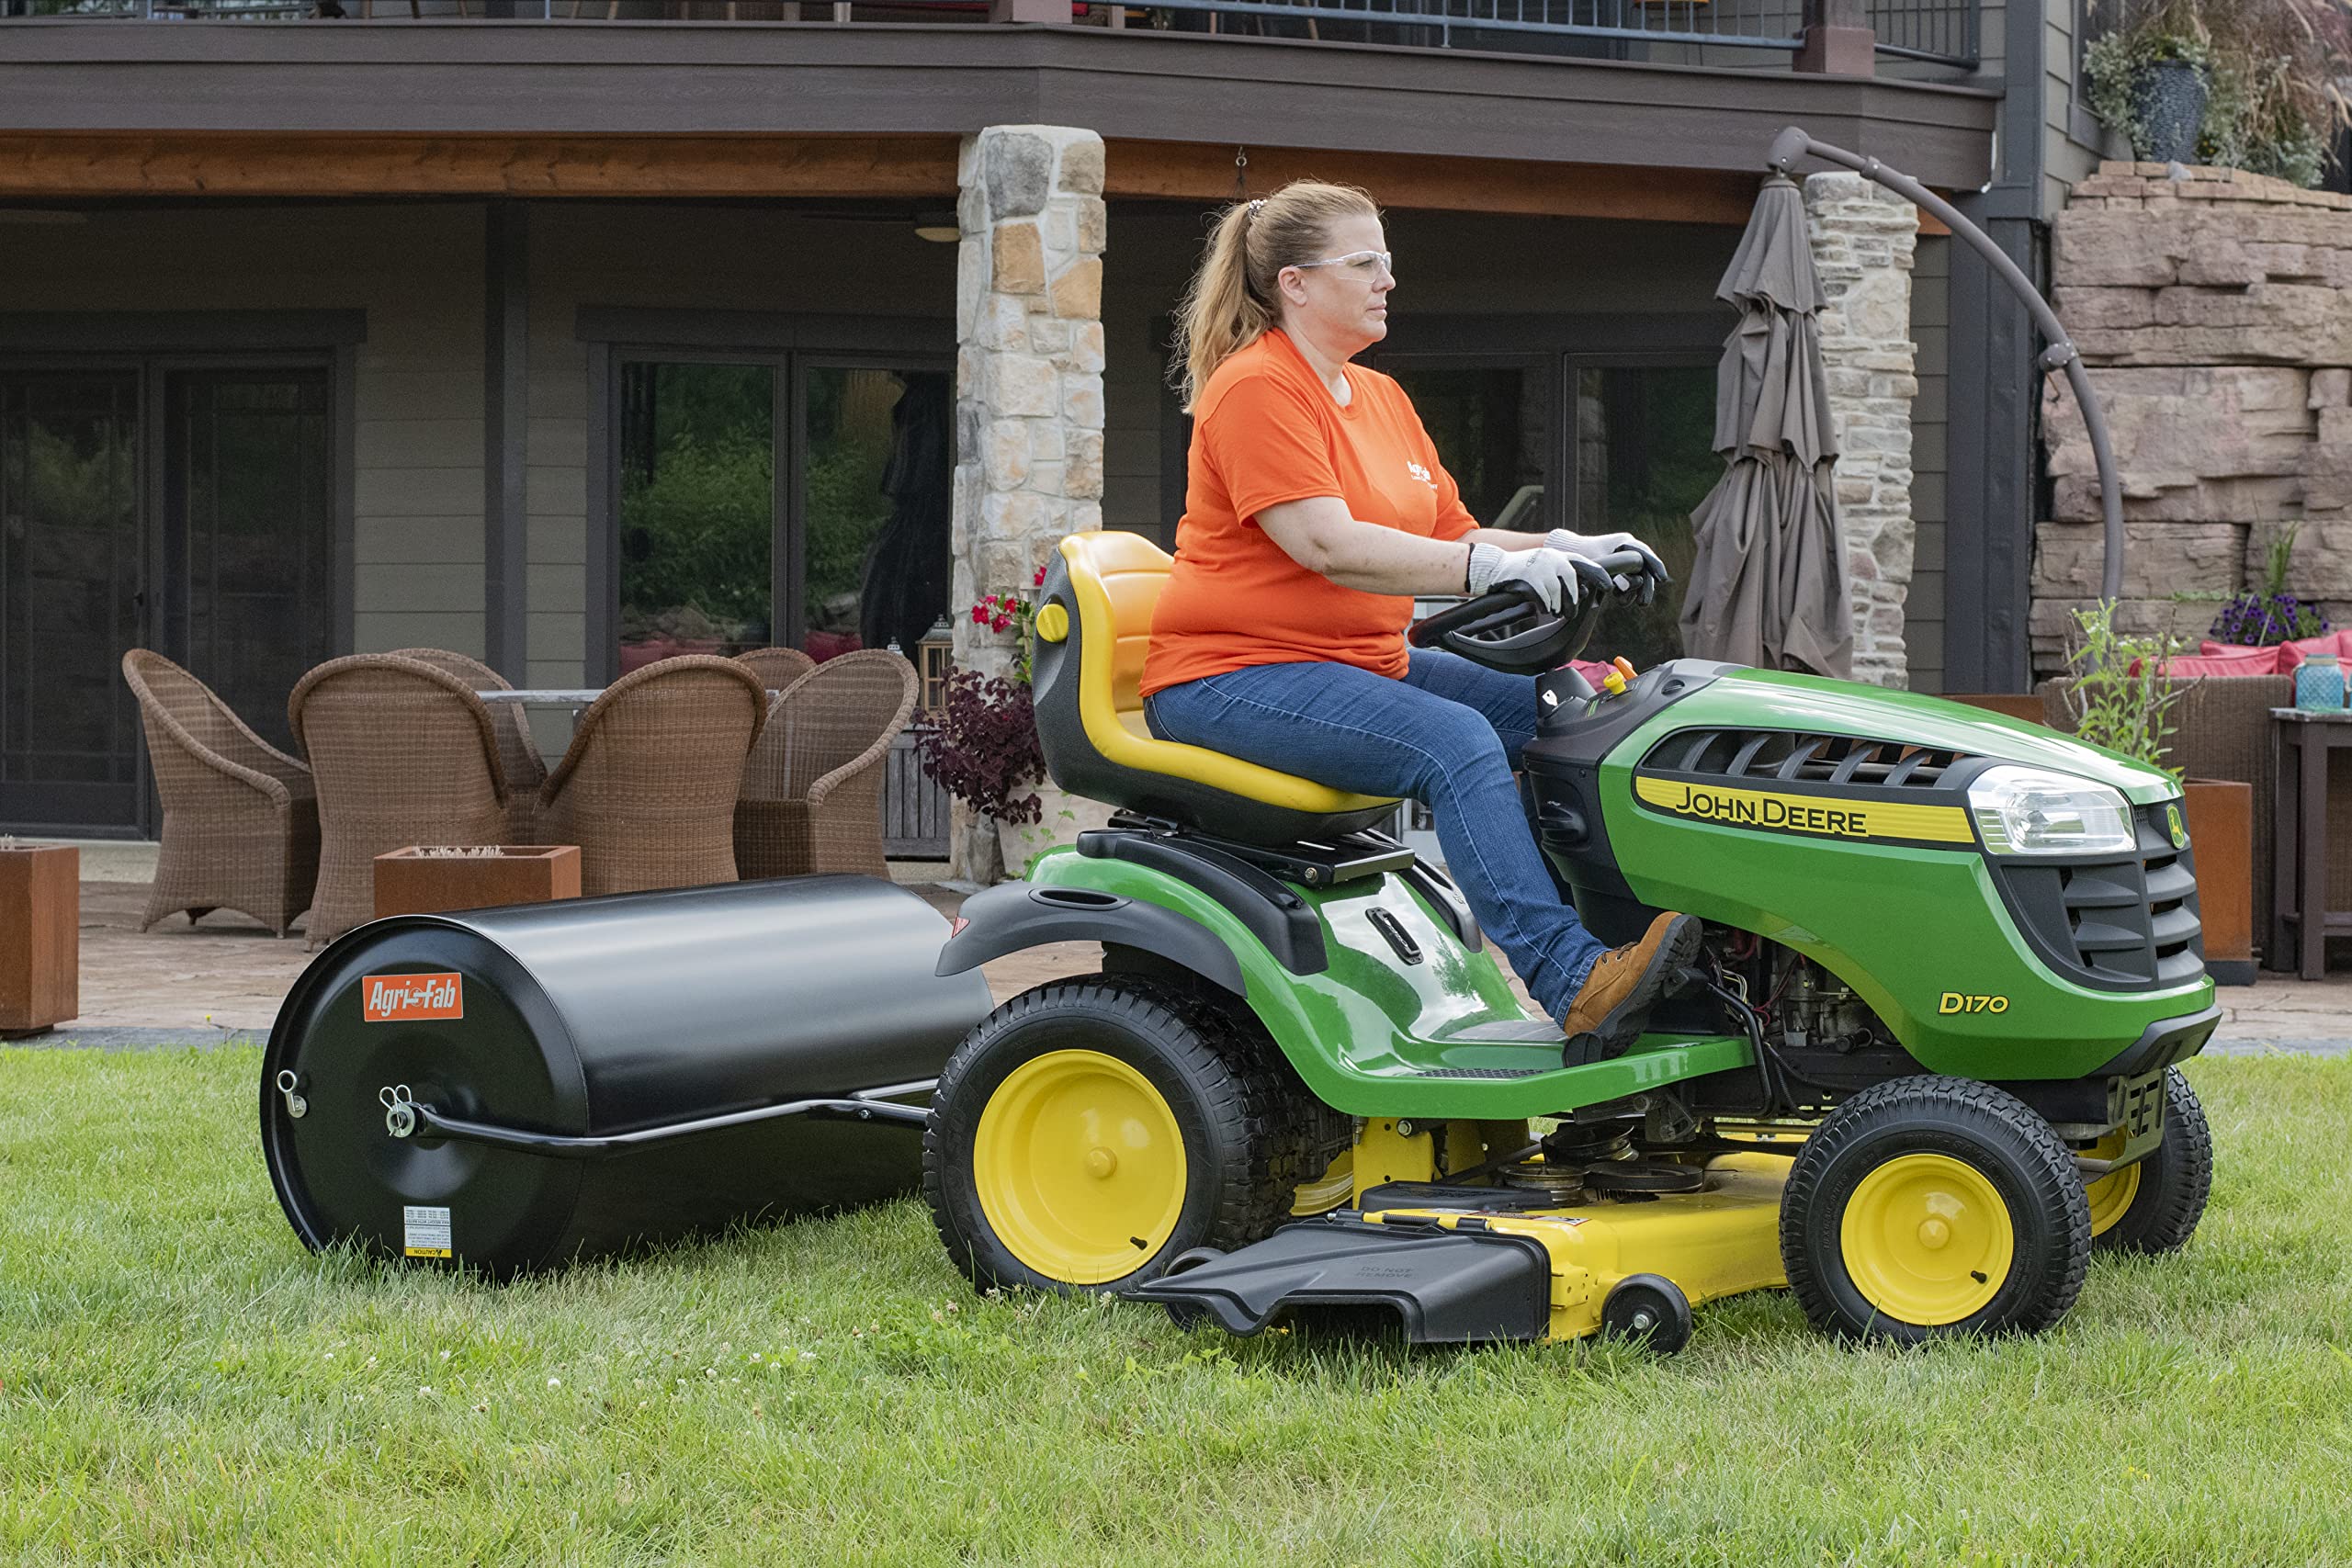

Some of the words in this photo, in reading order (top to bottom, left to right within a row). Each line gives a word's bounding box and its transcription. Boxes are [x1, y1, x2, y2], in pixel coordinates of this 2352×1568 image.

[1675, 785, 1756, 822] JOHN
[1763, 797, 1868, 834] DEERE
[368, 978, 457, 1017] Agri-Fab
[1939, 992, 2009, 1014] D170
